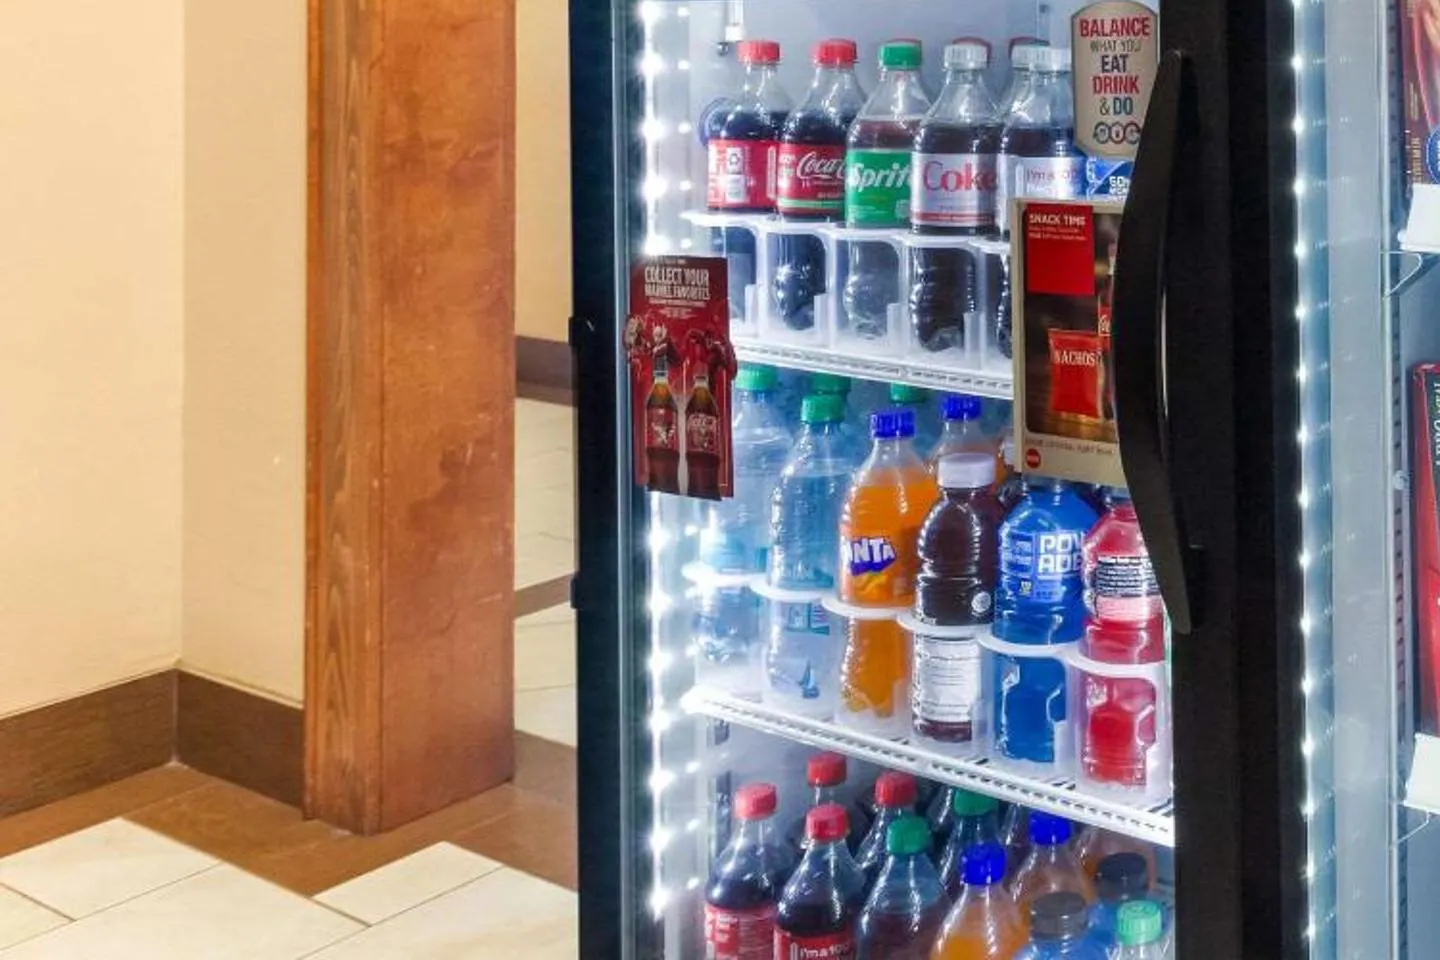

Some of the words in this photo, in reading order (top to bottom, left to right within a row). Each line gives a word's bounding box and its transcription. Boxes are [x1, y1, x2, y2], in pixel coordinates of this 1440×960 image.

[1080, 17, 1150, 38] BALANCE
[1101, 55, 1130, 74] EAT
[1092, 76, 1141, 95] DRINK
[1100, 98, 1110, 116] &
[1113, 97, 1134, 116] DO
[847, 159, 911, 194] Sprit
[922, 160, 998, 193] Coke
[1029, 213, 1060, 225] SNACK
[1063, 215, 1086, 227] TIME
[644, 267, 682, 285] COLLECT
[683, 268, 710, 287] YOUR
